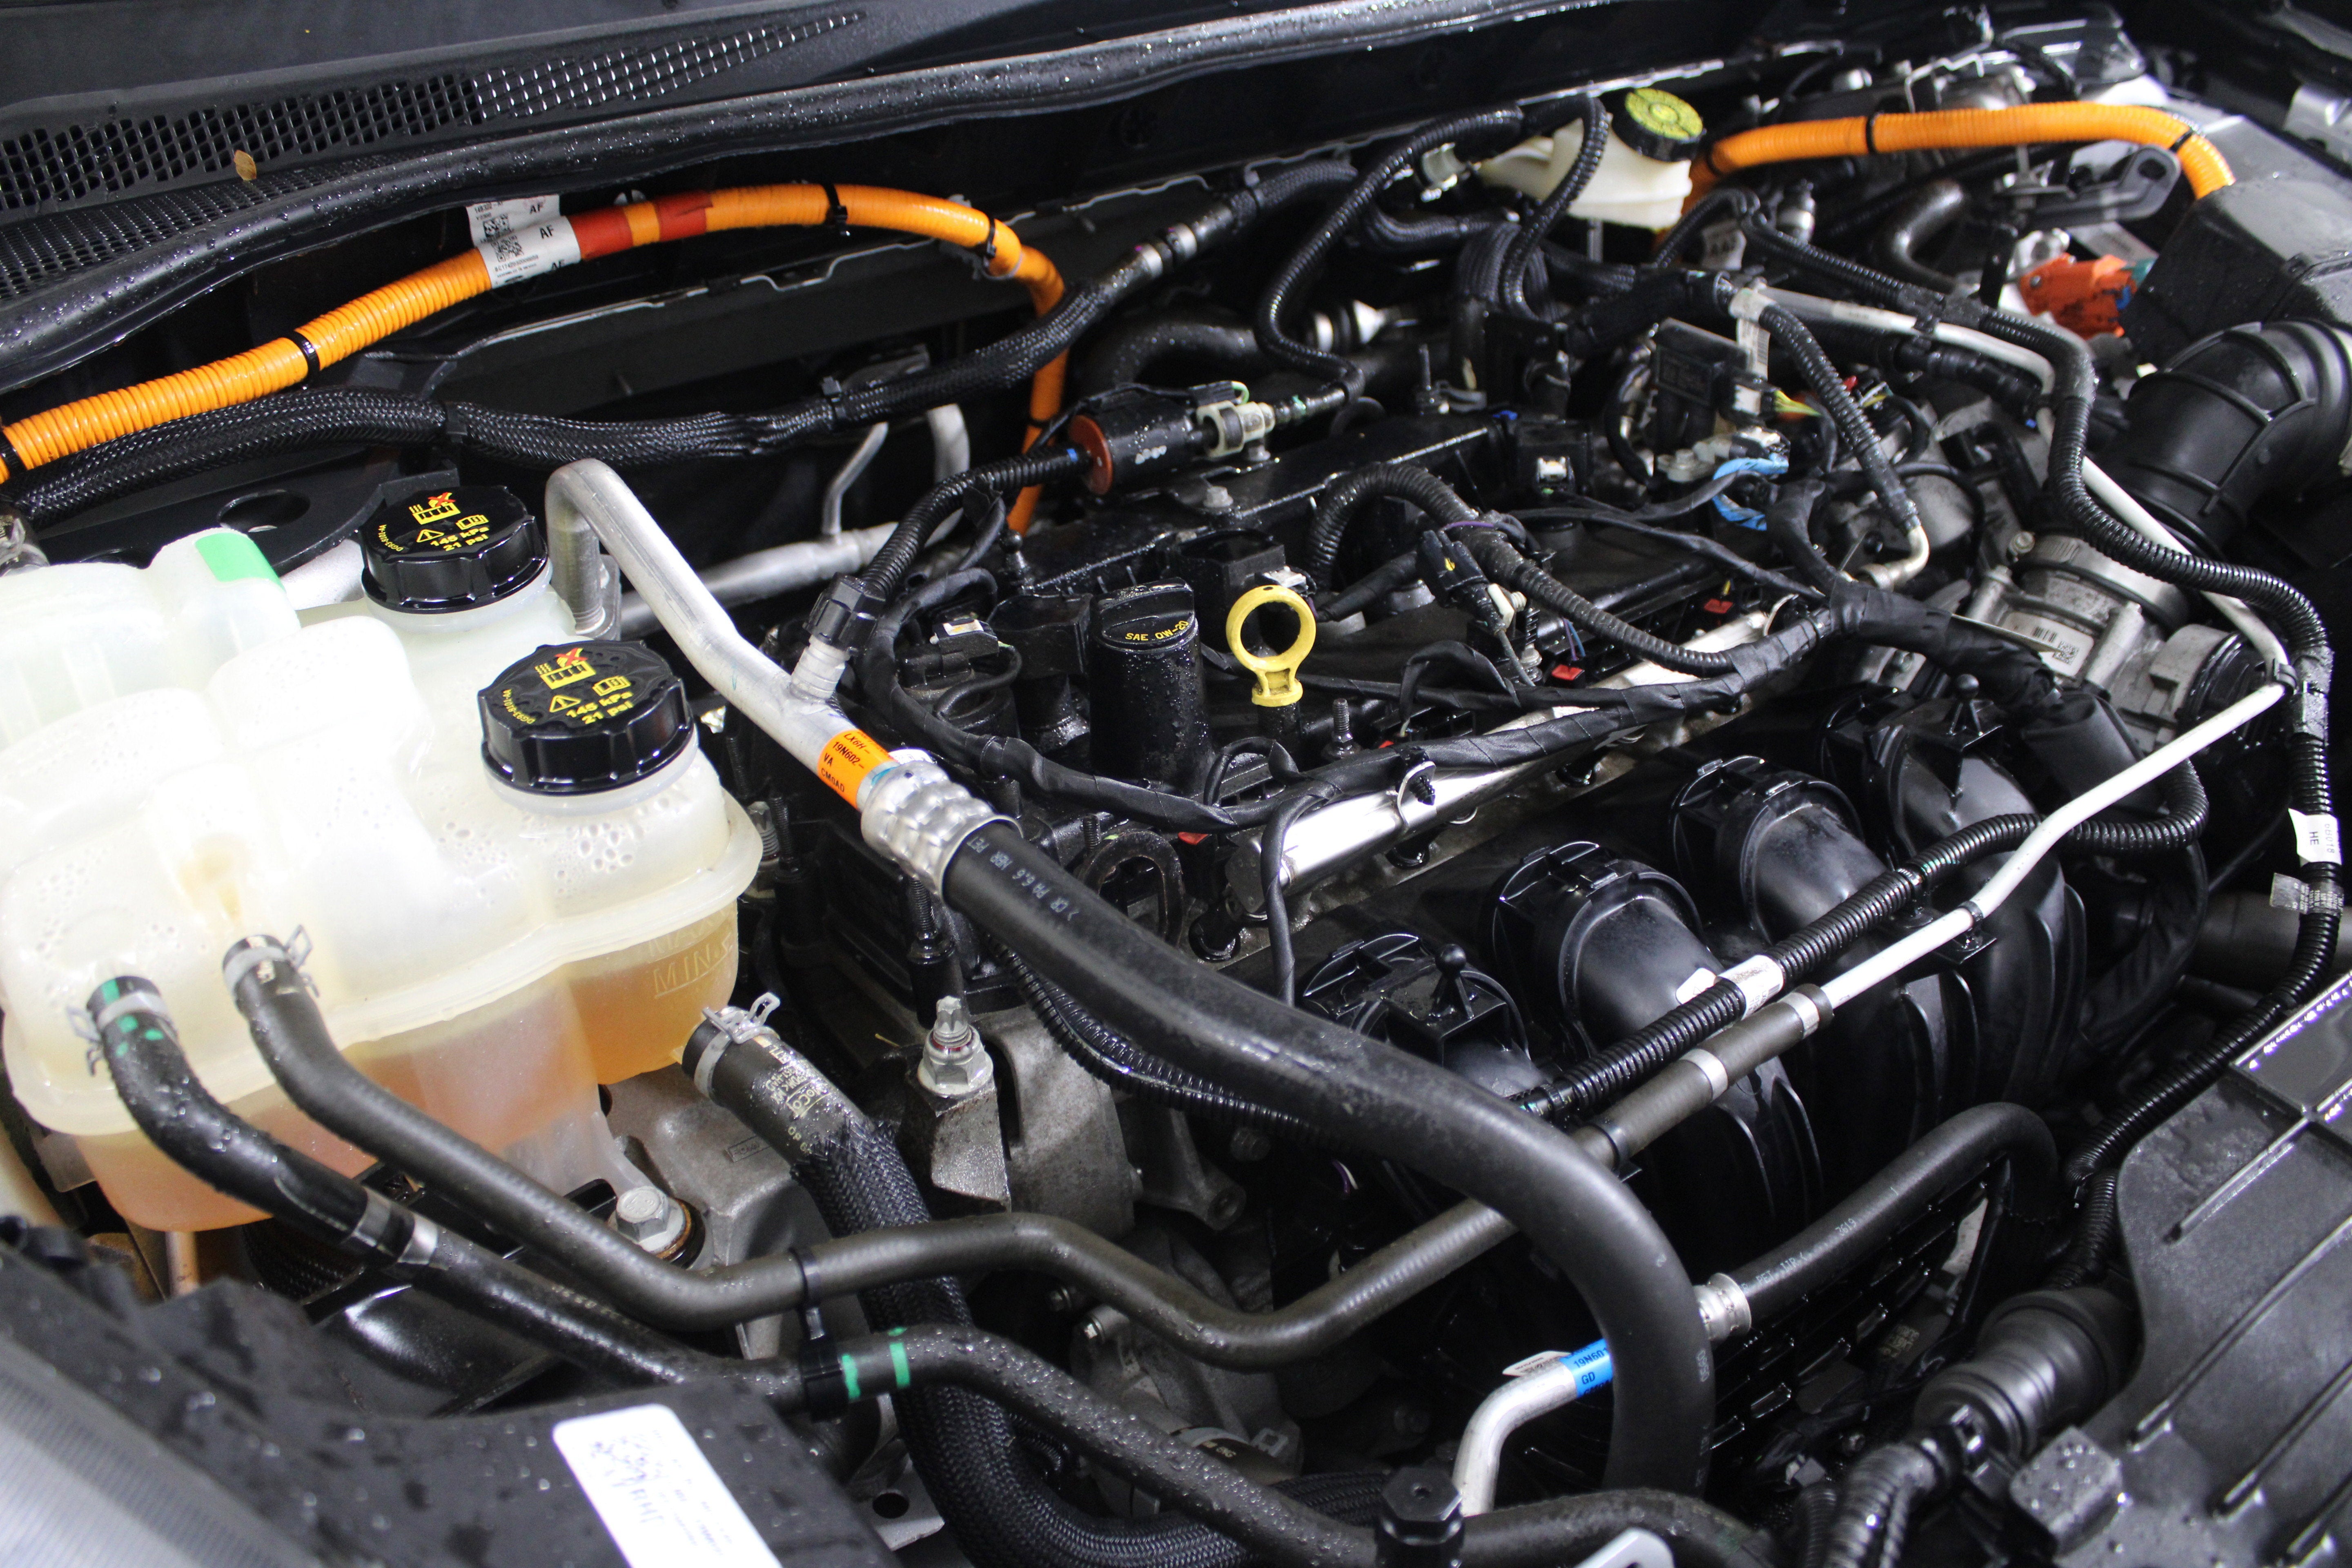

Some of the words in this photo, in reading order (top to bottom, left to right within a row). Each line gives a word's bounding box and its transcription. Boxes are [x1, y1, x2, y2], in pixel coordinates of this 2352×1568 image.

[529, 201, 543, 214] AF
[539, 224, 554, 239] AF
[430, 535, 458, 547] 145
[460, 526, 490, 538] kPa
[443, 541, 462, 551] 21
[465, 534, 489, 546] psi
[1125, 632, 1149, 641] SAE
[566, 702, 599, 719] 145
[599, 690, 634, 707] kPa
[581, 711, 605, 725] 21
[606, 701, 635, 717] psi
[824, 753, 833, 767] VA
[2309, 831, 2320, 845] HE
[1581, 1372, 1597, 1385] GD
